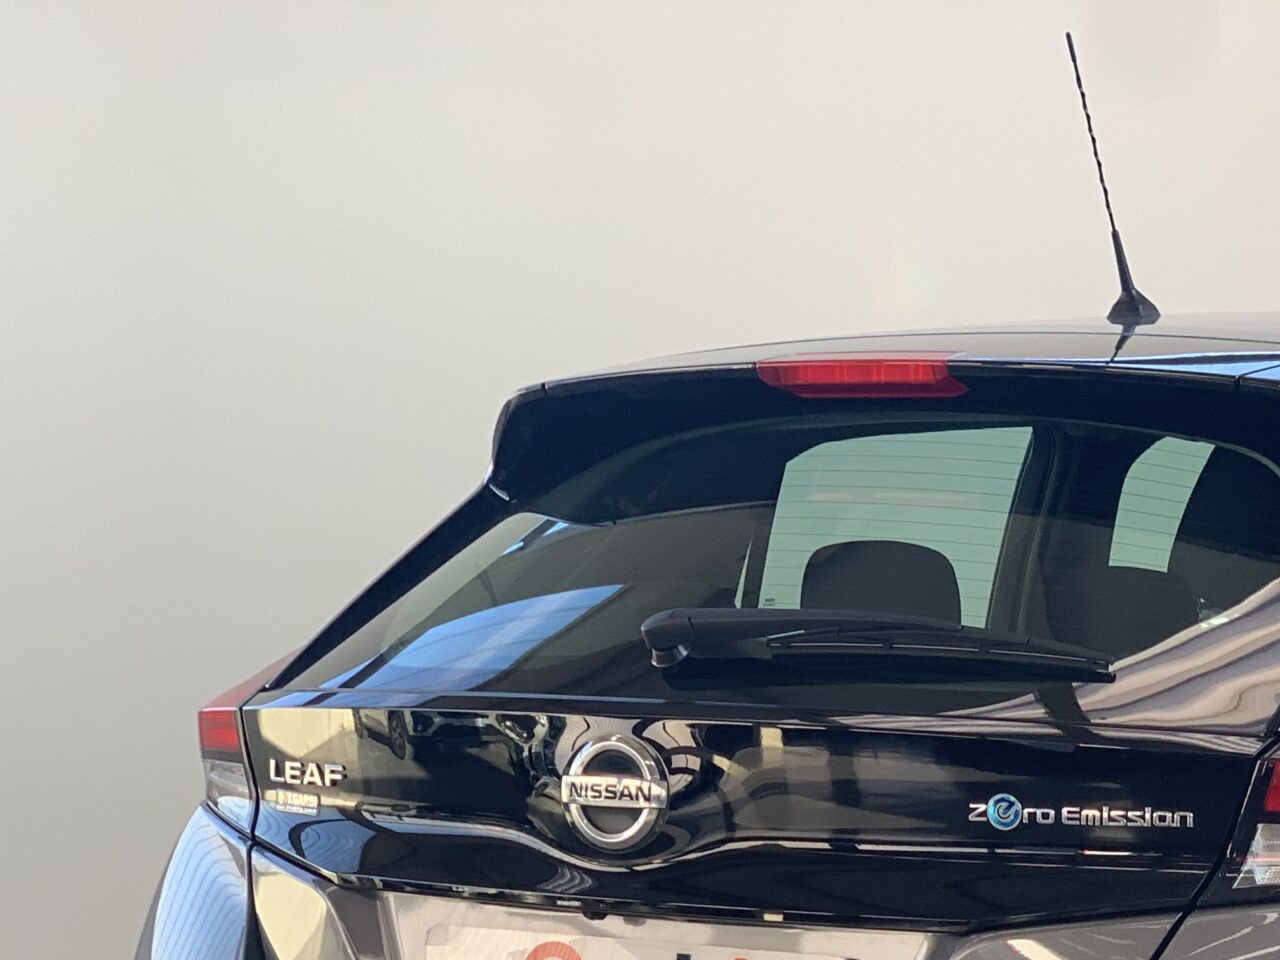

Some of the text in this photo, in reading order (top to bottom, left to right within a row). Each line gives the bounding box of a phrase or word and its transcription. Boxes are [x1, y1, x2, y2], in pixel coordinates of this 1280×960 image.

[269, 758, 346, 787] LEAF
[569, 781, 652, 803] NISSAN
[1060, 805, 1194, 829] Emission
